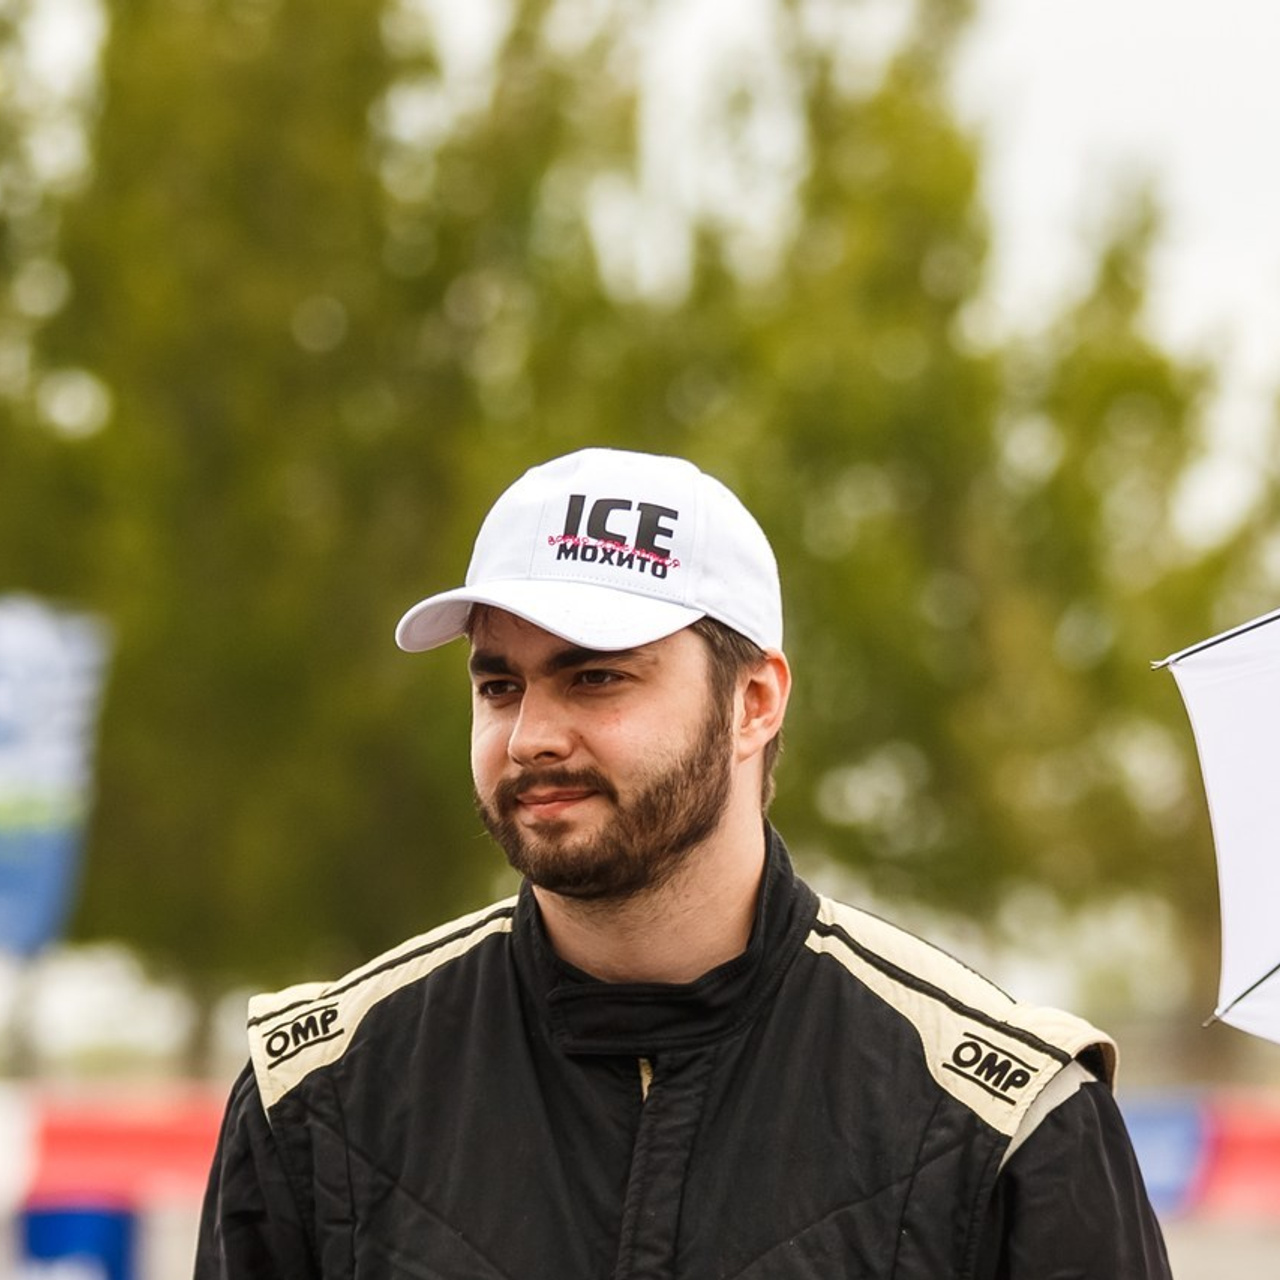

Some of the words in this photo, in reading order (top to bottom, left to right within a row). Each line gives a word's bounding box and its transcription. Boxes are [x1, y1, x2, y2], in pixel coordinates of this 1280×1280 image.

[563, 494, 679, 559] ICE
[556, 542, 668, 579] МОХИТО
[266, 1009, 338, 1058] OMP
[952, 1041, 1031, 1092] OMP
